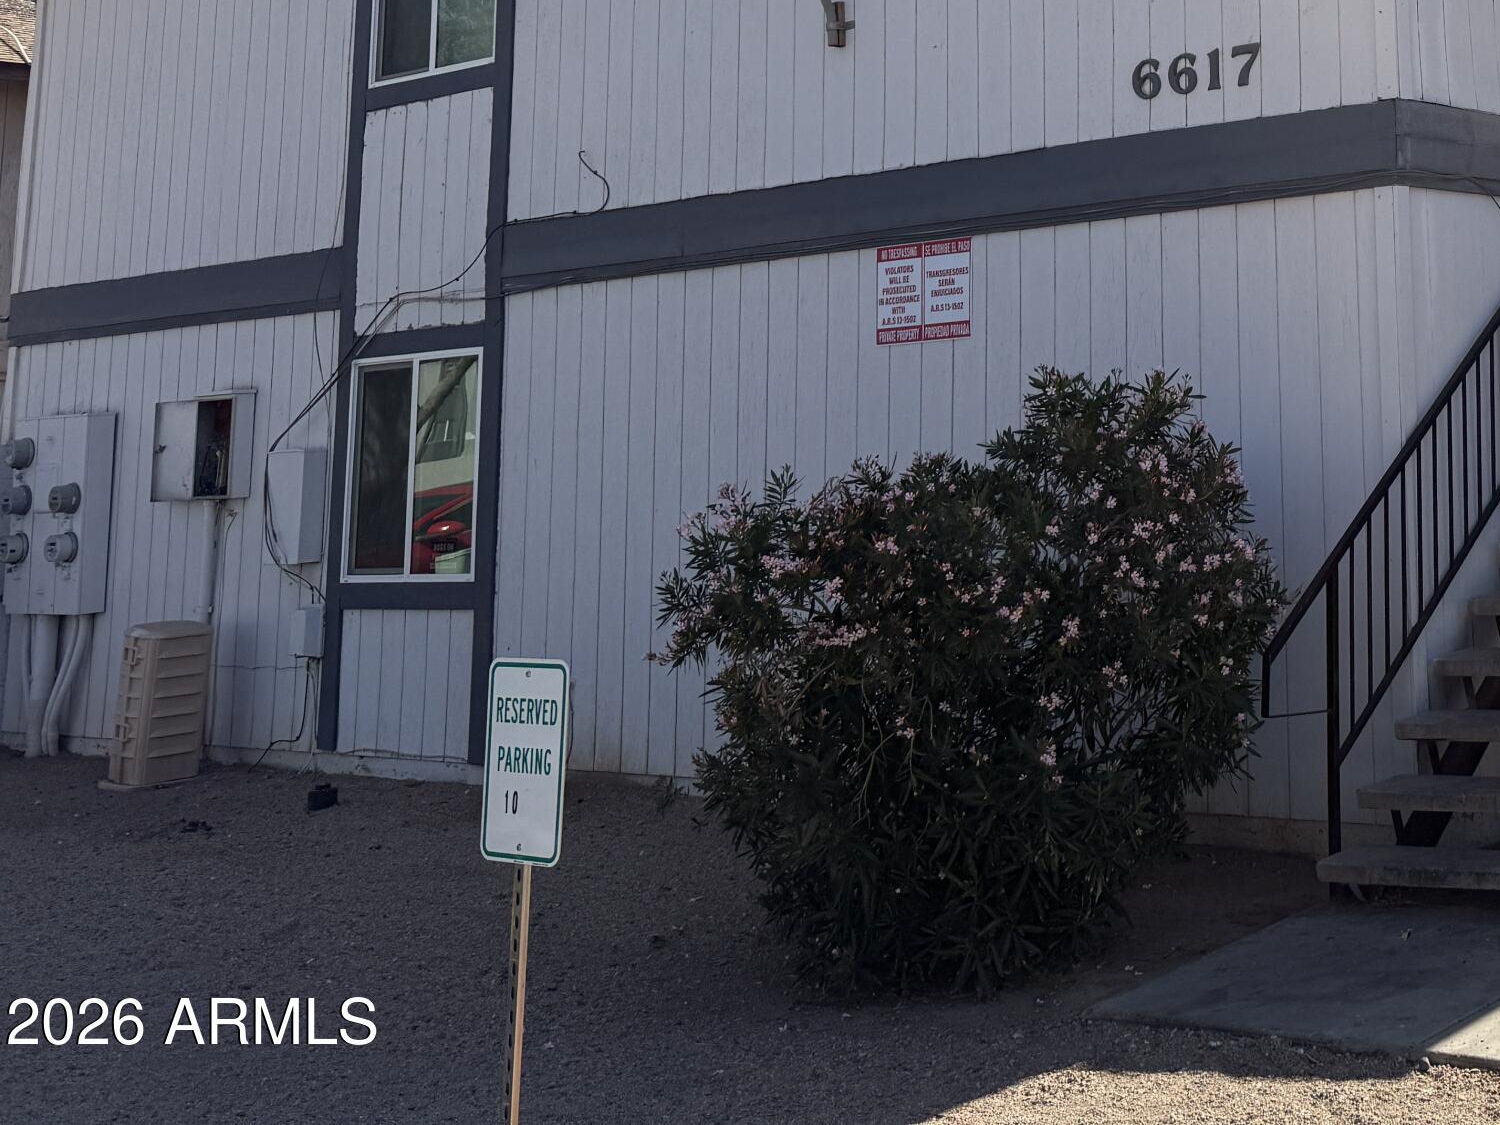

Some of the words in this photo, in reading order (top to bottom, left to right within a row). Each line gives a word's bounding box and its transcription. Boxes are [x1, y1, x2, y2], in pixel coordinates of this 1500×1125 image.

[1131, 42, 1261, 100] 6617
[885, 265, 914, 275] VIOLATORS
[889, 276, 902, 285] WILL
[882, 285, 917, 296] PROSECUTED
[885, 294, 920, 305] ACCORDANCE
[892, 306, 906, 315] WITH
[496, 697, 558, 726] RESERVED
[497, 745, 552, 776] PARKING
[505, 790, 519, 815] 10
